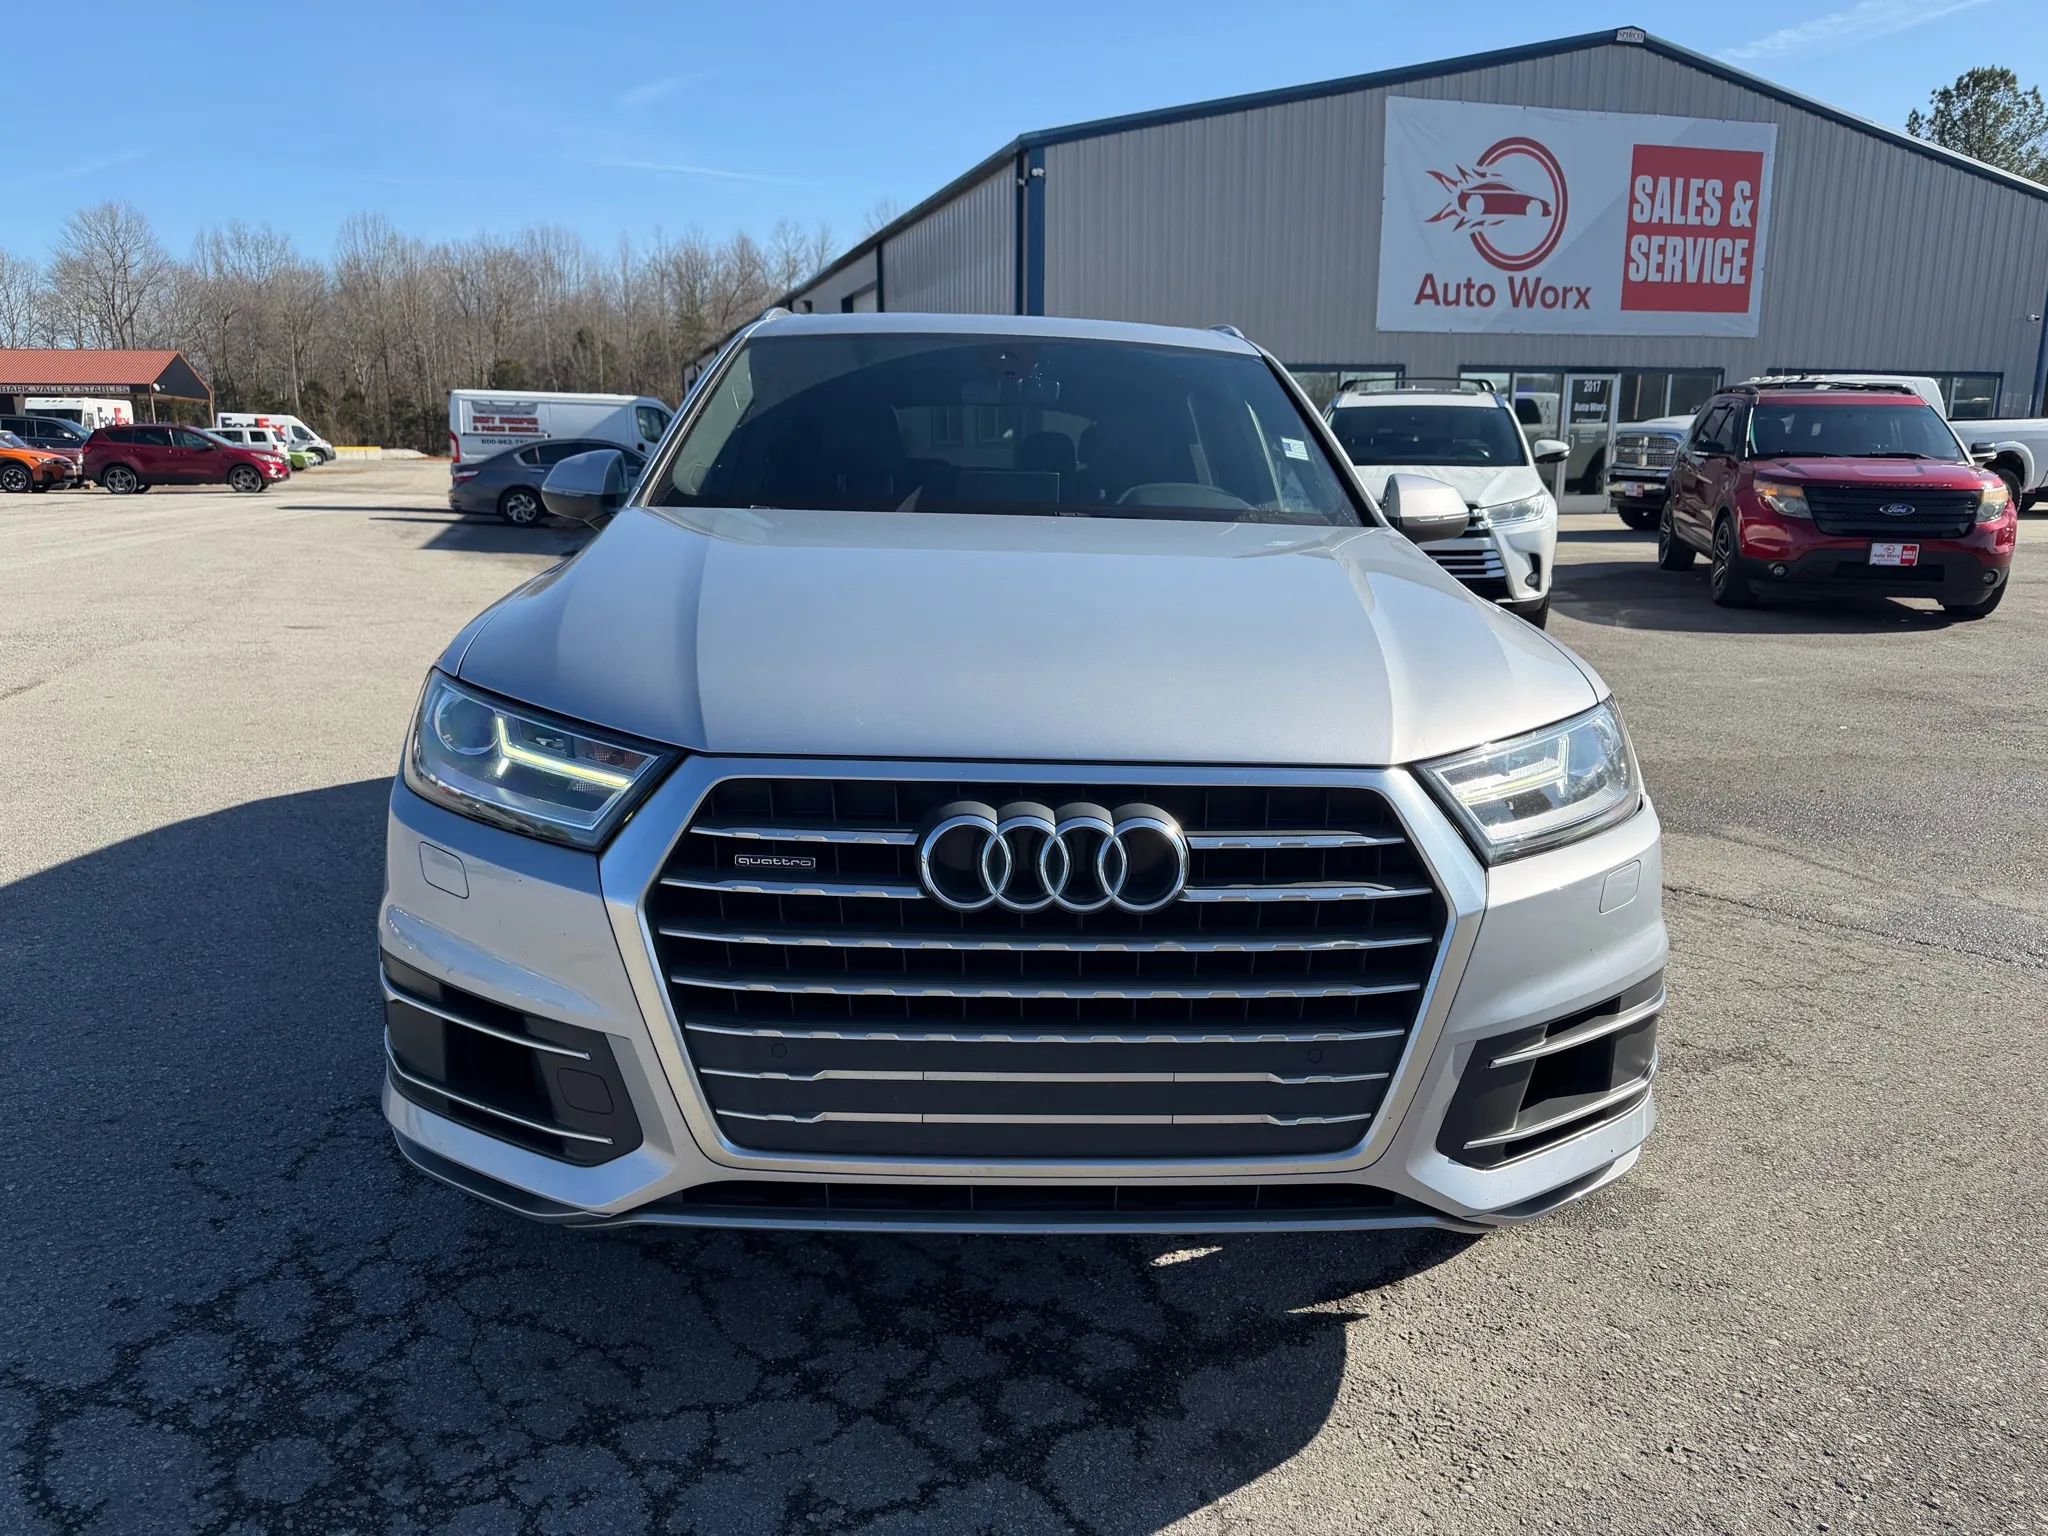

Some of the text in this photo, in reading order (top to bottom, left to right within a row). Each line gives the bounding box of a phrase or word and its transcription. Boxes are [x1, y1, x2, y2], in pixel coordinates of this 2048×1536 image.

[1632, 175, 1753, 228] SALES &
[1628, 234, 1749, 285] SERVICE
[1413, 272, 1592, 310] Auto Worx
[0, 385, 130, 394] BARK VALLEY STABLES
[1583, 380, 1601, 393] 2017
[1574, 402, 1607, 412] Auto Worx
[1888, 503, 1907, 513] Ford
[738, 857, 812, 866] quattro
